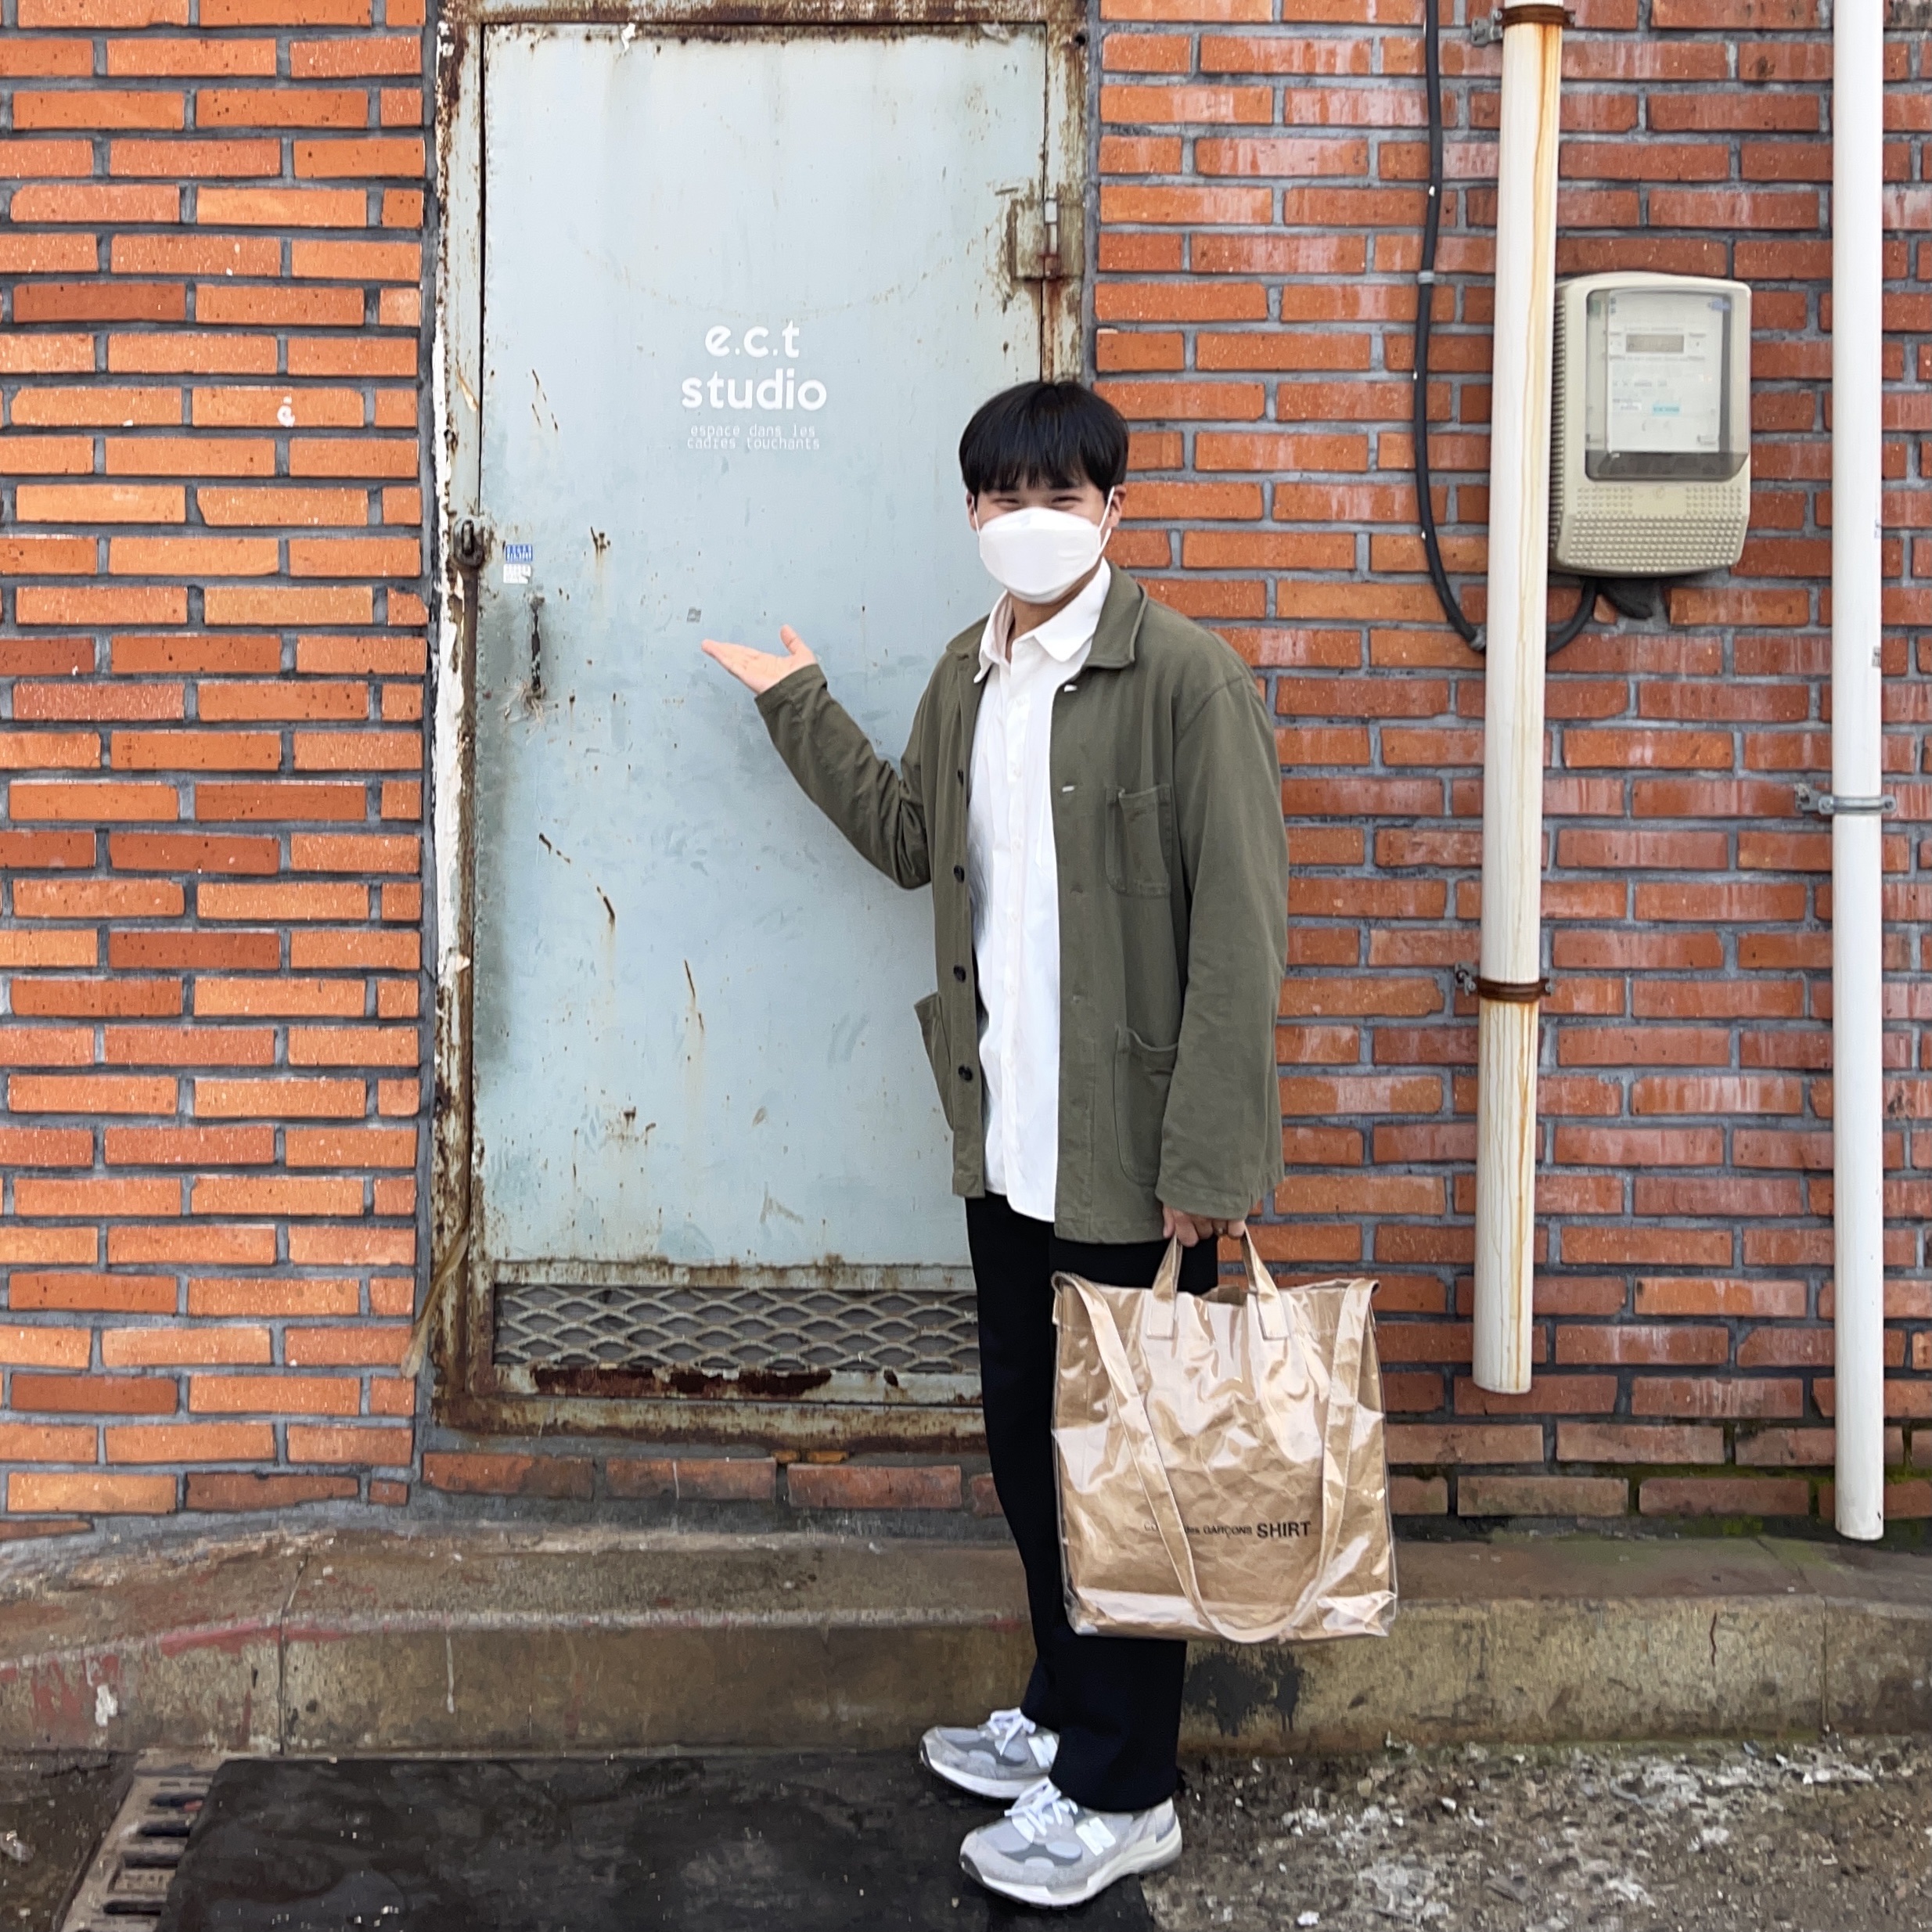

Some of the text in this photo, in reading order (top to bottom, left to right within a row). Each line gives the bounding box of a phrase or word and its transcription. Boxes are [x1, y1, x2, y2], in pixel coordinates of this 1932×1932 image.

[705, 318, 799, 358] e.c.t
[682, 368, 826, 411] studio
[687, 436, 820, 450] cadres touchants
[691, 423, 815, 438] espace dans les
[1256, 1520, 1312, 1539] SHIRT
[1075, 1817, 1117, 1857] N
